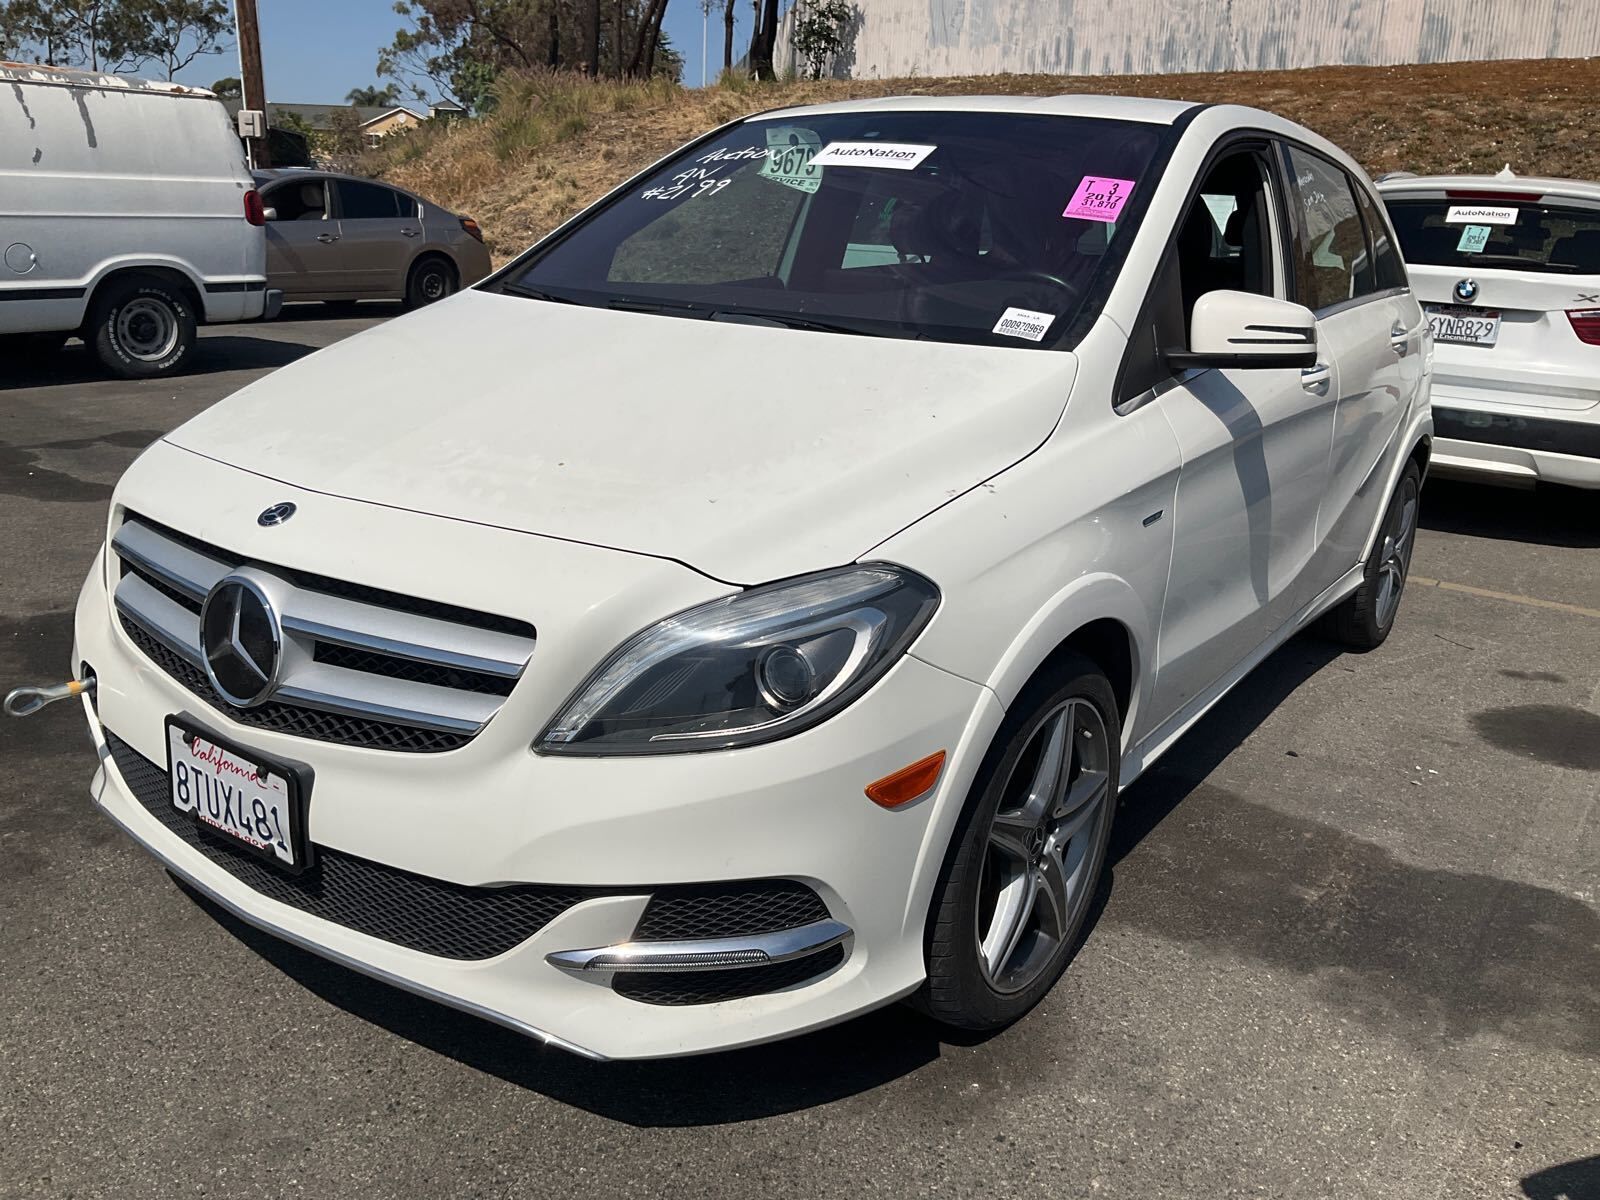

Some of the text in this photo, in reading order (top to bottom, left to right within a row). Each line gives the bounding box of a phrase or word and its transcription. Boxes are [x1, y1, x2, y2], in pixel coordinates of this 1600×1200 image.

[696, 145, 797, 163] Auction
[826, 147, 918, 160] AutoNation
[672, 164, 728, 185] AN
[771, 176, 806, 187] RVICE
[1085, 180, 1096, 192] T
[1109, 183, 1119, 195] 3
[1086, 193, 1123, 202] 2017
[1453, 209, 1511, 218] AutoNation
[1001, 319, 1044, 334] 000970969
[191, 736, 268, 789] California
[177, 761, 288, 853] 8TUX481
